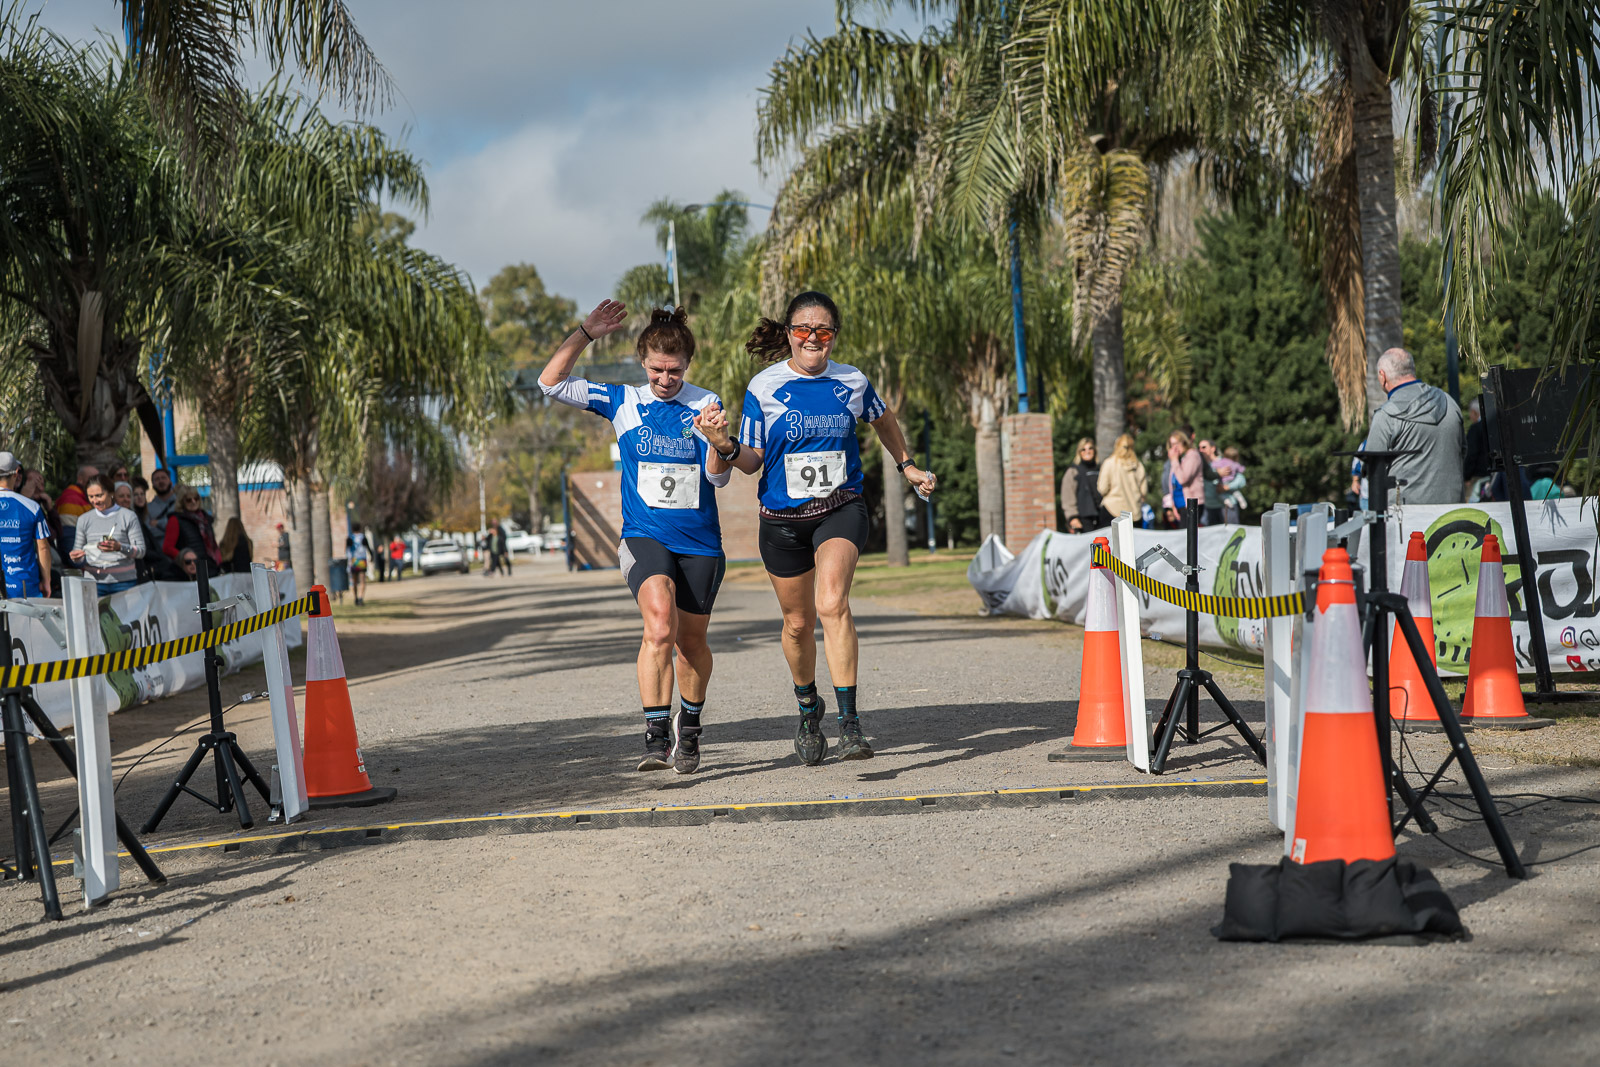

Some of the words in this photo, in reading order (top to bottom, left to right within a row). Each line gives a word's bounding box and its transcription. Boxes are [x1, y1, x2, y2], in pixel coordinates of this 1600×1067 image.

[785, 409, 803, 442] 3
[804, 413, 851, 429] MARATÓN
[636, 425, 653, 456] 3
[660, 475, 676, 498] 9
[800, 464, 833, 488] 91
